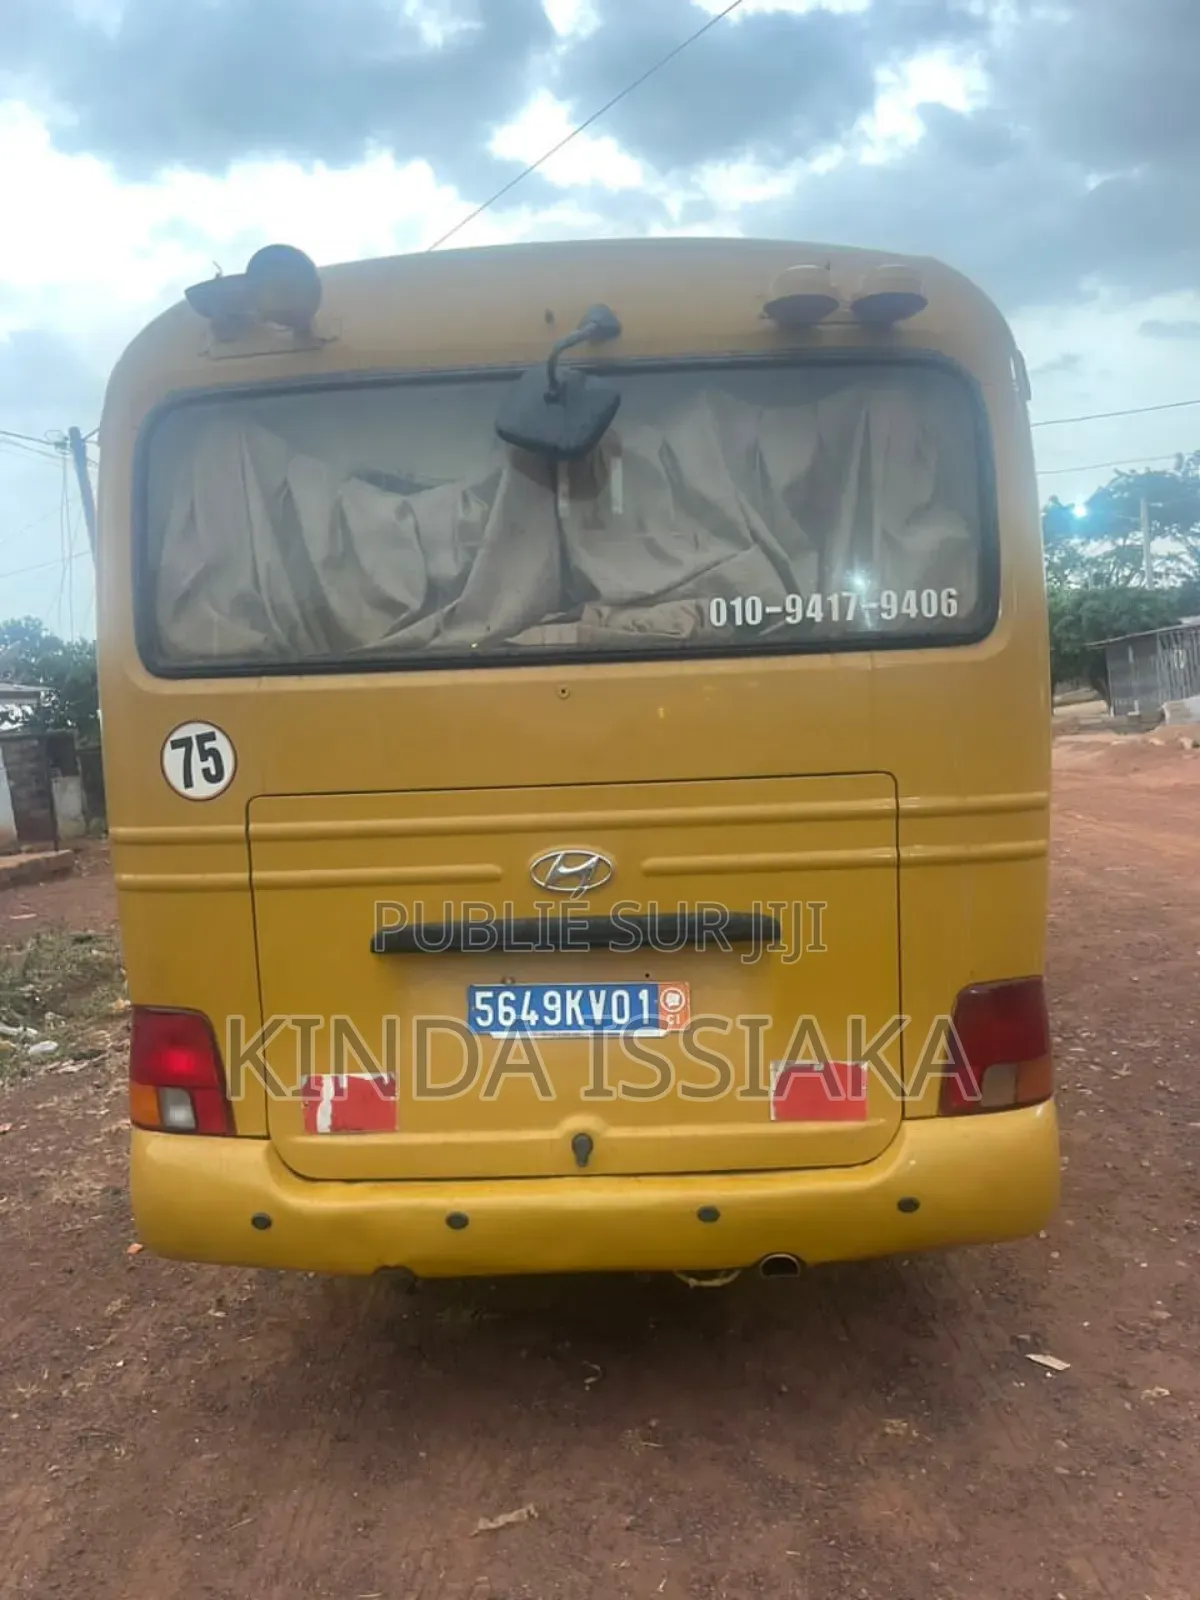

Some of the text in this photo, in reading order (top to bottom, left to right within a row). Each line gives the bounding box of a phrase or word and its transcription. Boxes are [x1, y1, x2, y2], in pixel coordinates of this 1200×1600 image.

[709, 587, 959, 627] 010-9417-9406
[169, 730, 225, 790] 75
[473, 988, 650, 1028] 5649KV01
